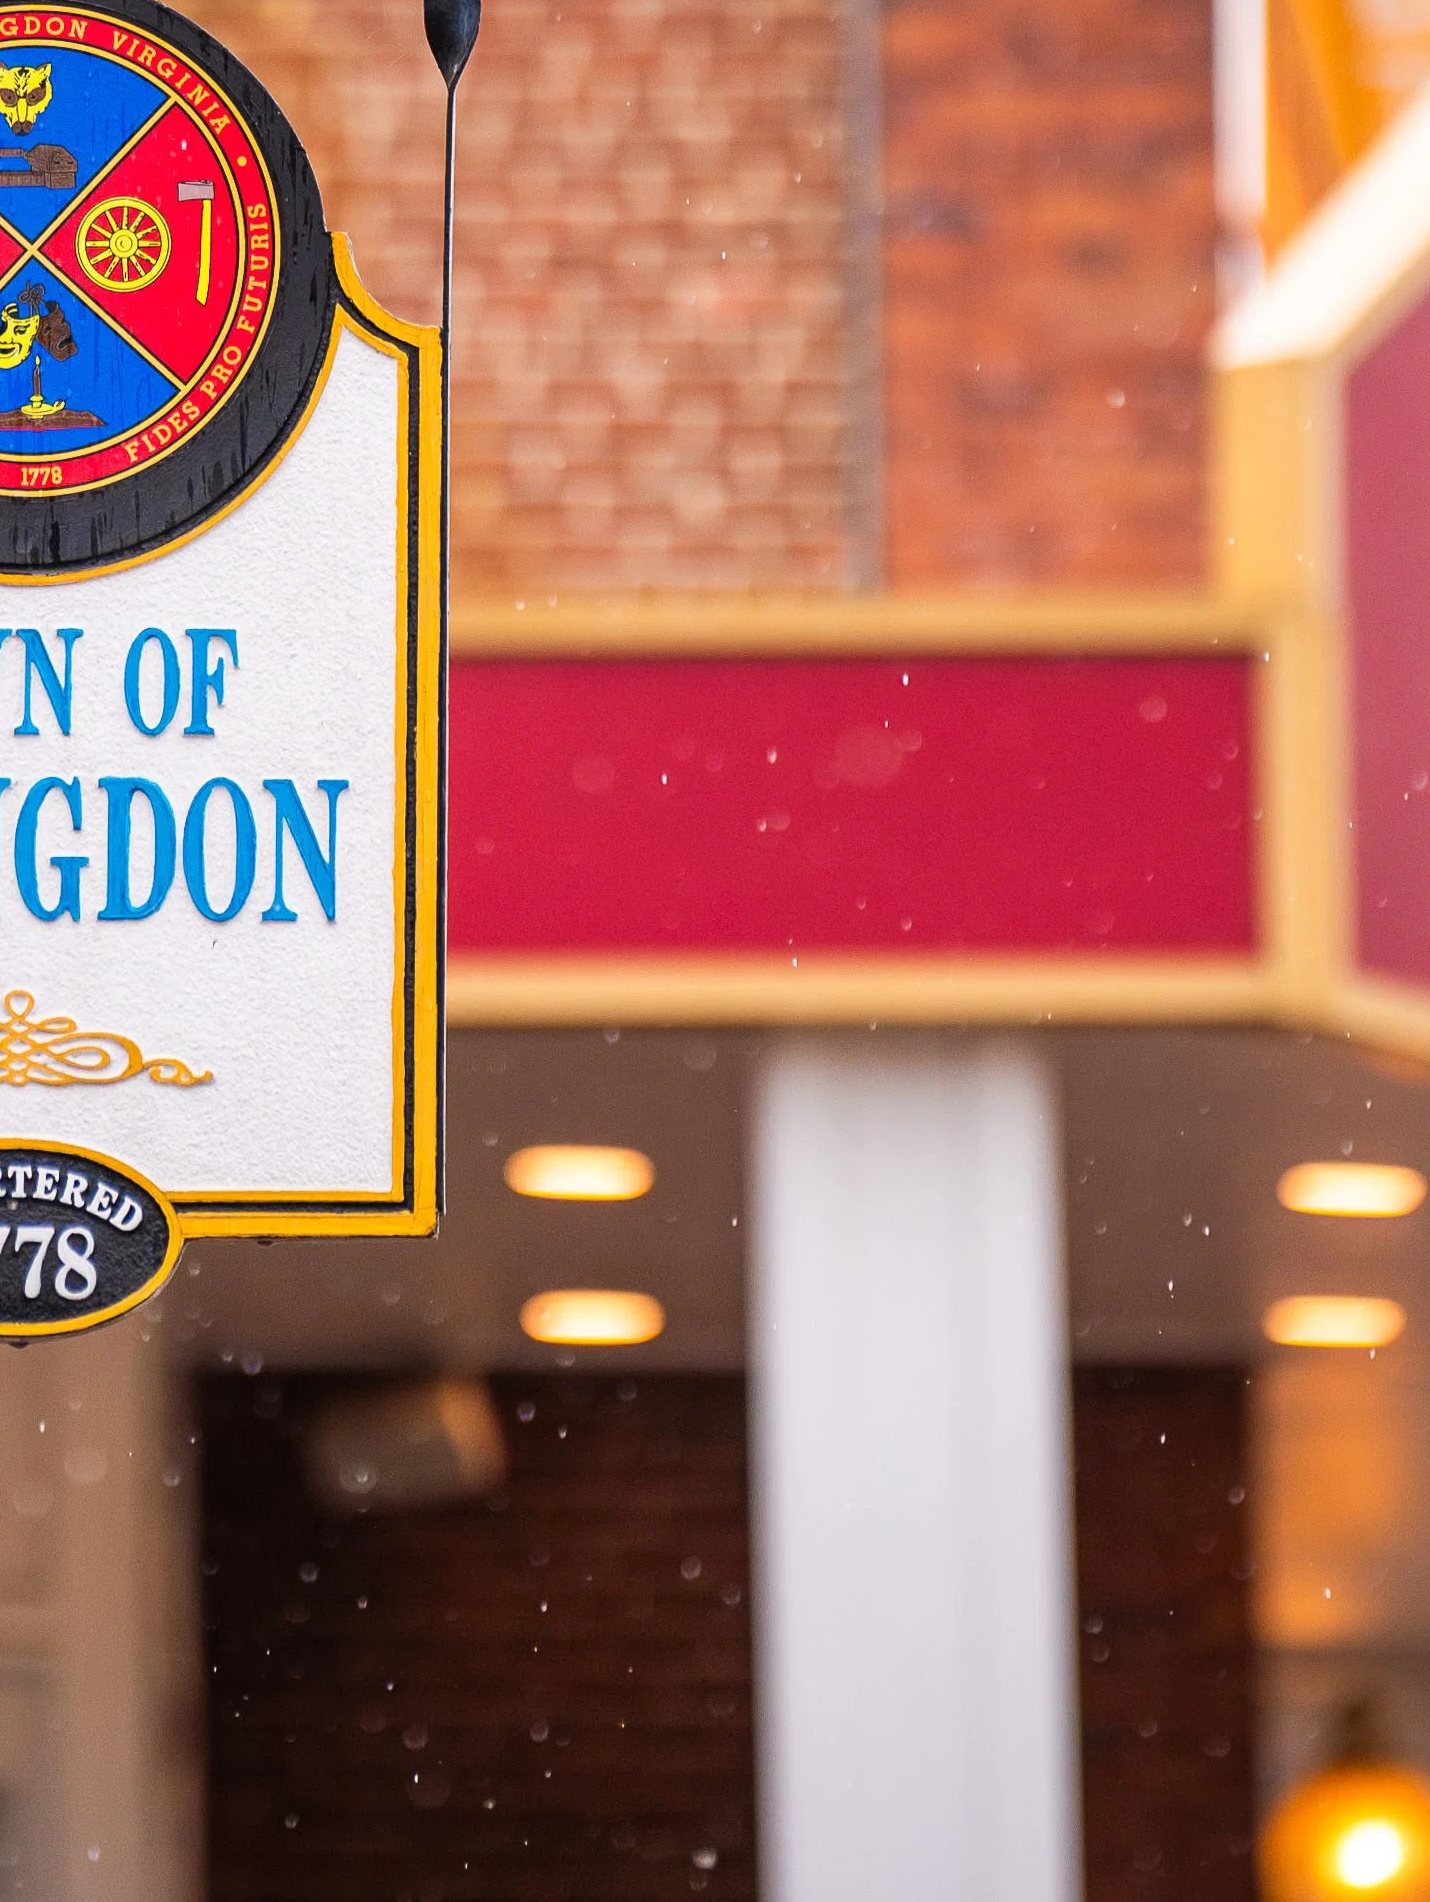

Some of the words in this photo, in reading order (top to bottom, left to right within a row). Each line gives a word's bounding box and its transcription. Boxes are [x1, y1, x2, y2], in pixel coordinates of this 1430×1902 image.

[111, 30, 230, 136] VIRGINIA
[126, 402, 202, 462] FIDES
[201, 344, 244, 400] PRO
[236, 202, 268, 337] FUTURIS
[20, 465, 63, 486] 1778
[124, 627, 238, 736] OF
